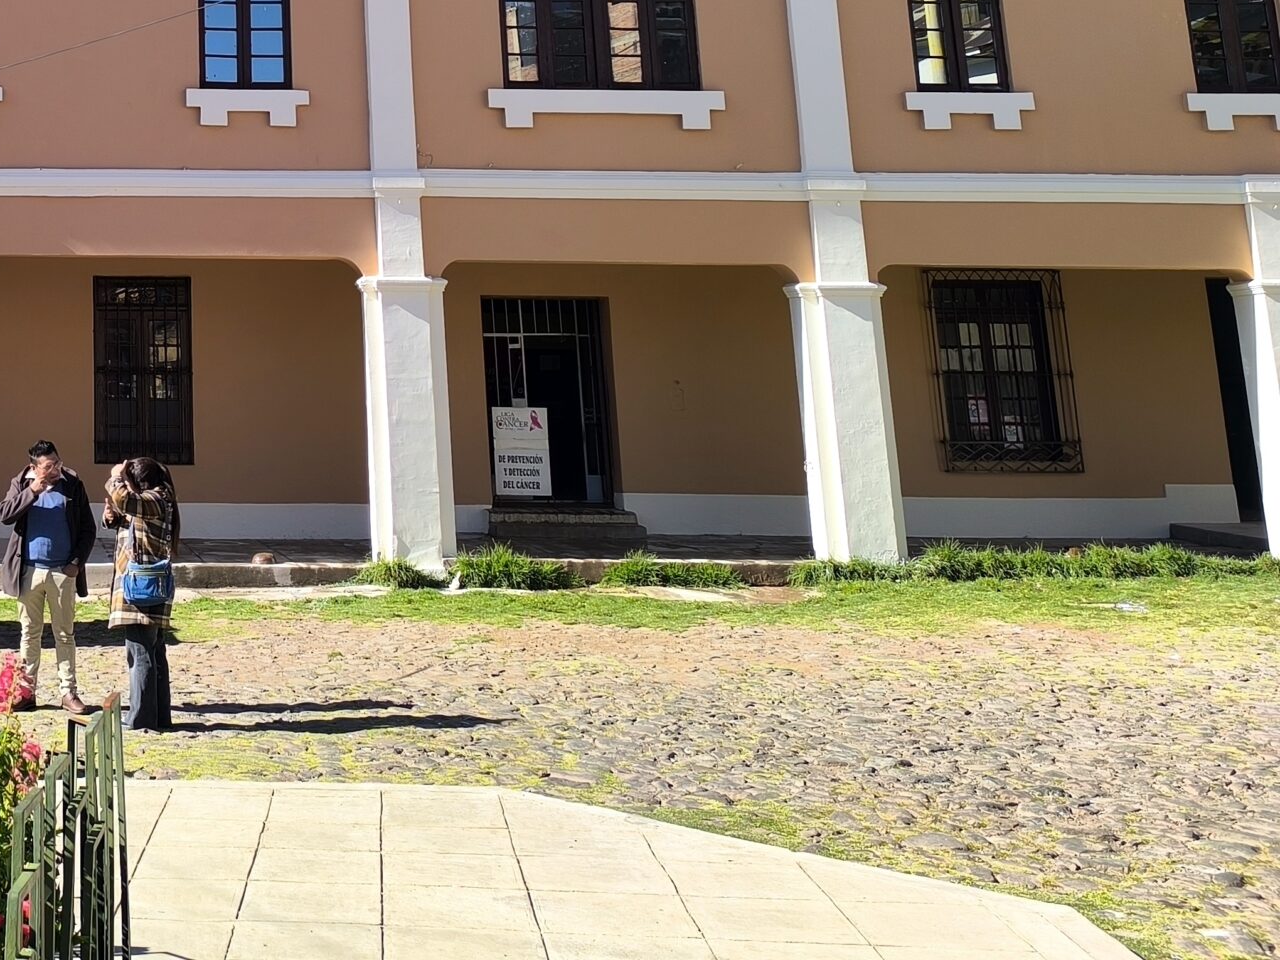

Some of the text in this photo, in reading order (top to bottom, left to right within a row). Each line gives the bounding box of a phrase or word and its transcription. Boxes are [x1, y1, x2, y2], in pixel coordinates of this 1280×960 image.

[498, 454, 544, 464] DE PREVENCIÓN
[504, 466, 540, 477] Y DETECCIÓN
[503, 480, 515, 489] DEL
